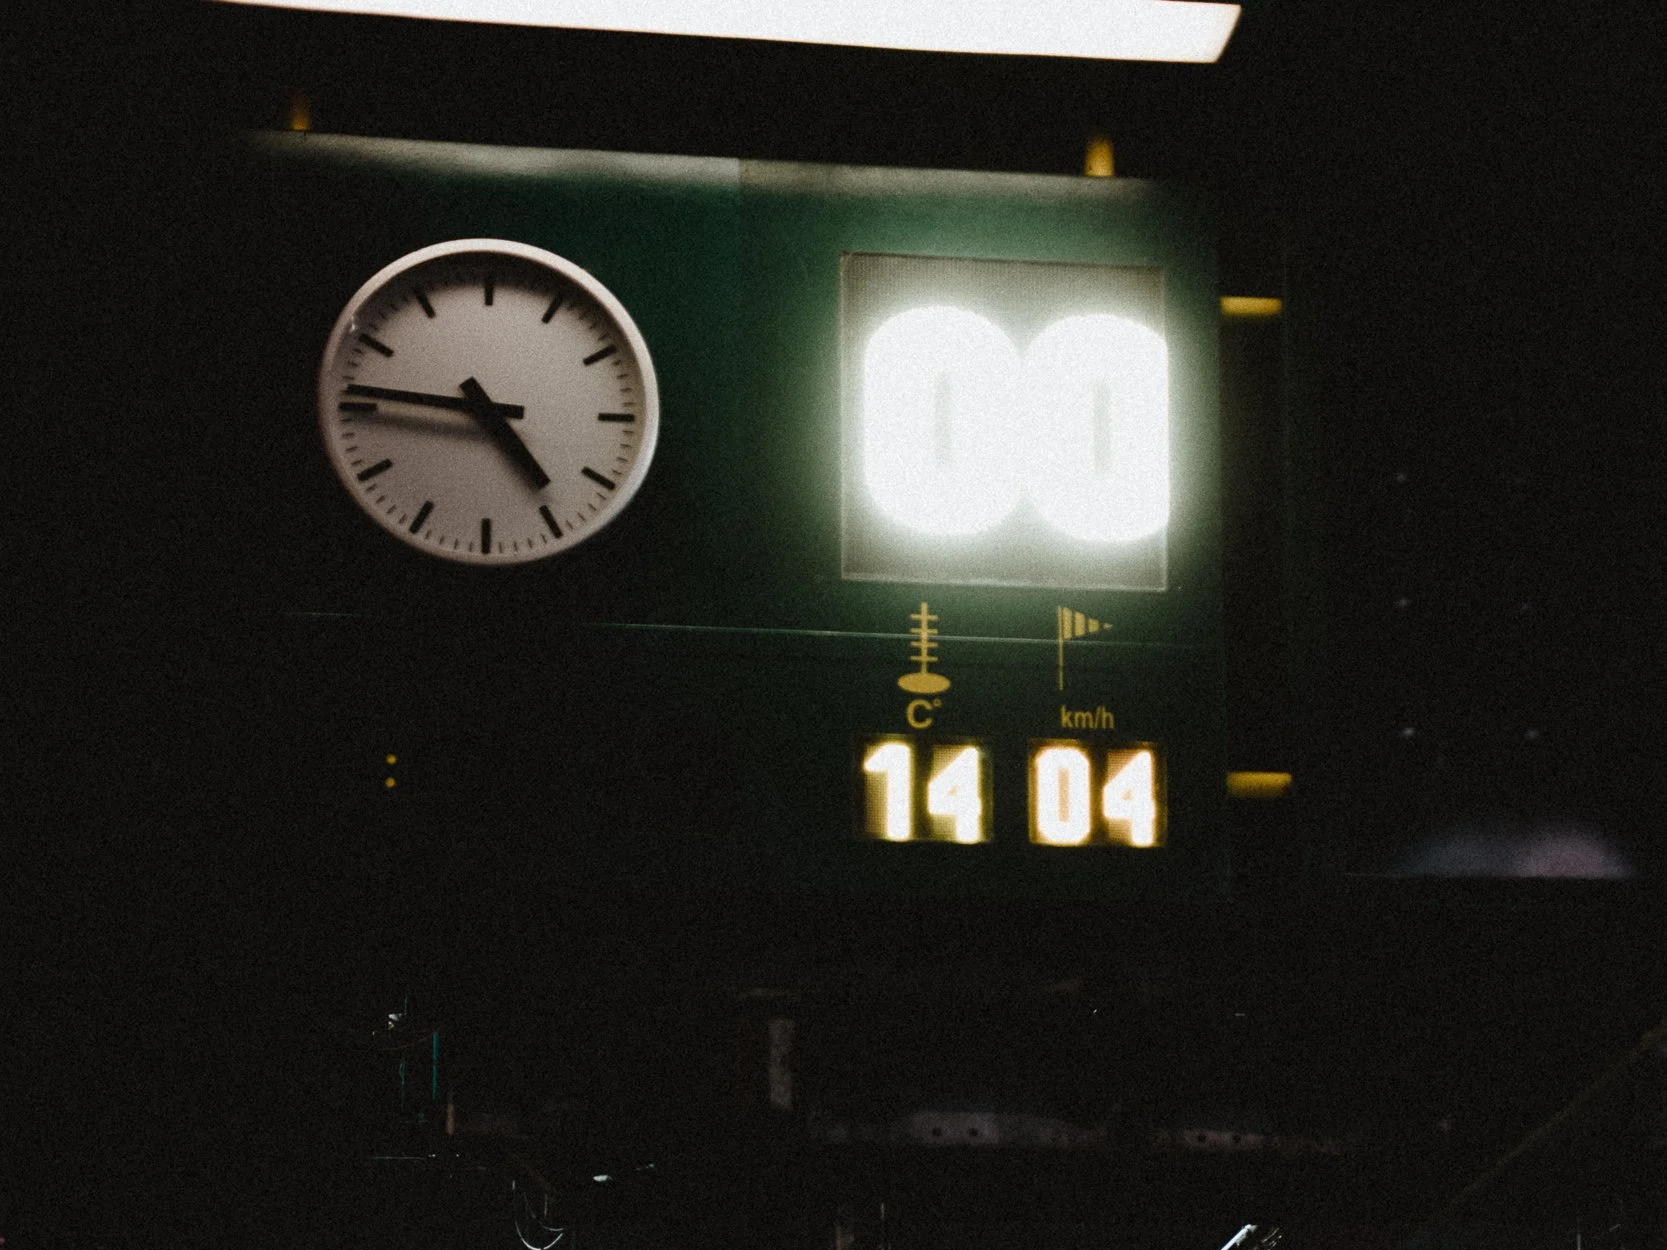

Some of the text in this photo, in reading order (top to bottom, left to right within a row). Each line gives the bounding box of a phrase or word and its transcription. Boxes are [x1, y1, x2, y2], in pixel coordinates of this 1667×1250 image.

[862, 304, 1170, 541] 00
[1060, 704, 1115, 729] km/h
[863, 742, 983, 845] 14
[1035, 746, 1157, 848] 04
